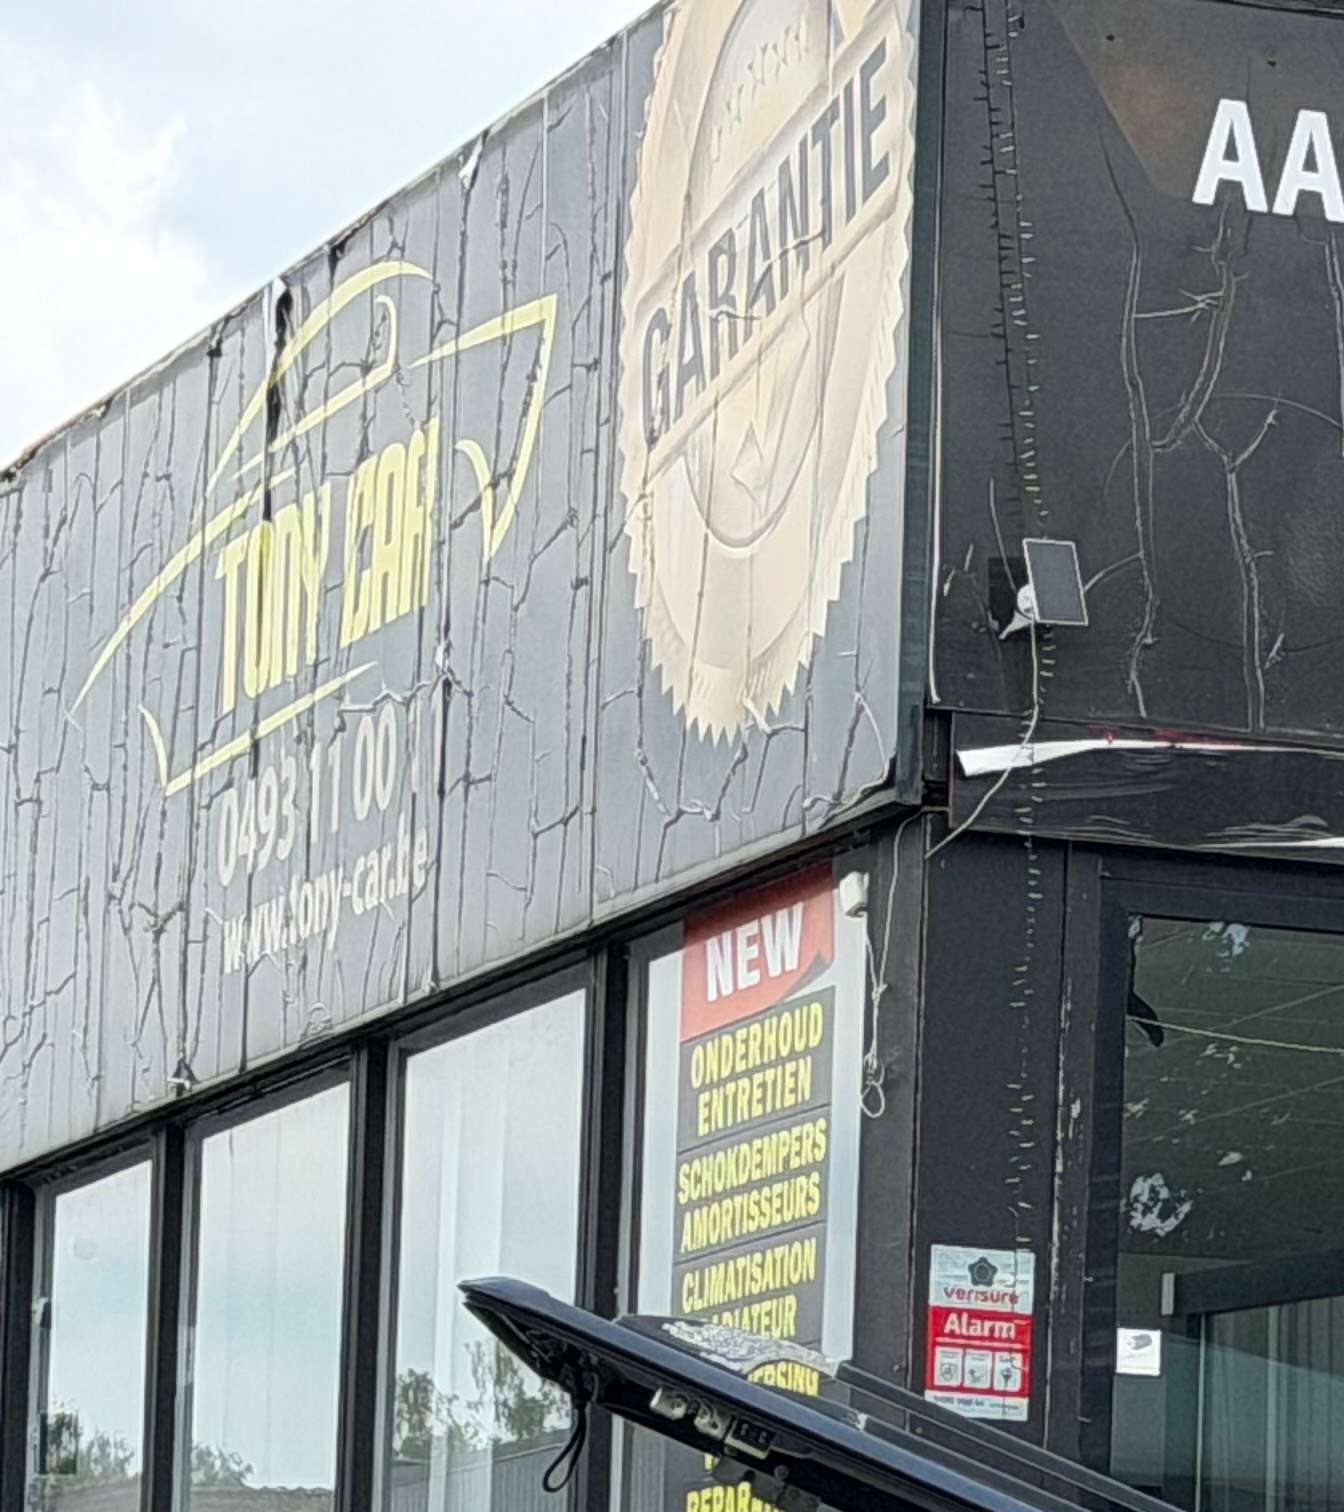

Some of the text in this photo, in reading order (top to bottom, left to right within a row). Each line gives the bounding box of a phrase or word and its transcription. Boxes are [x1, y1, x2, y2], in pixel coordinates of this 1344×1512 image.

[641, 36, 891, 449] GARANTIE
[215, 480, 331, 716] TONY
[217, 754, 297, 887] 0493
[353, 702, 398, 822] 00
[706, 901, 804, 1002] NEW
[691, 1002, 823, 1089] ONDERHOUD
[698, 1056, 812, 1137] ENTRETIEN
[678, 1117, 827, 1205] SCHOKDEMPERS
[680, 1171, 821, 1254] AMORTISSEURS
[682, 1237, 817, 1314] CLIMATISATION
[943, 1312, 1016, 1339] Alarm
